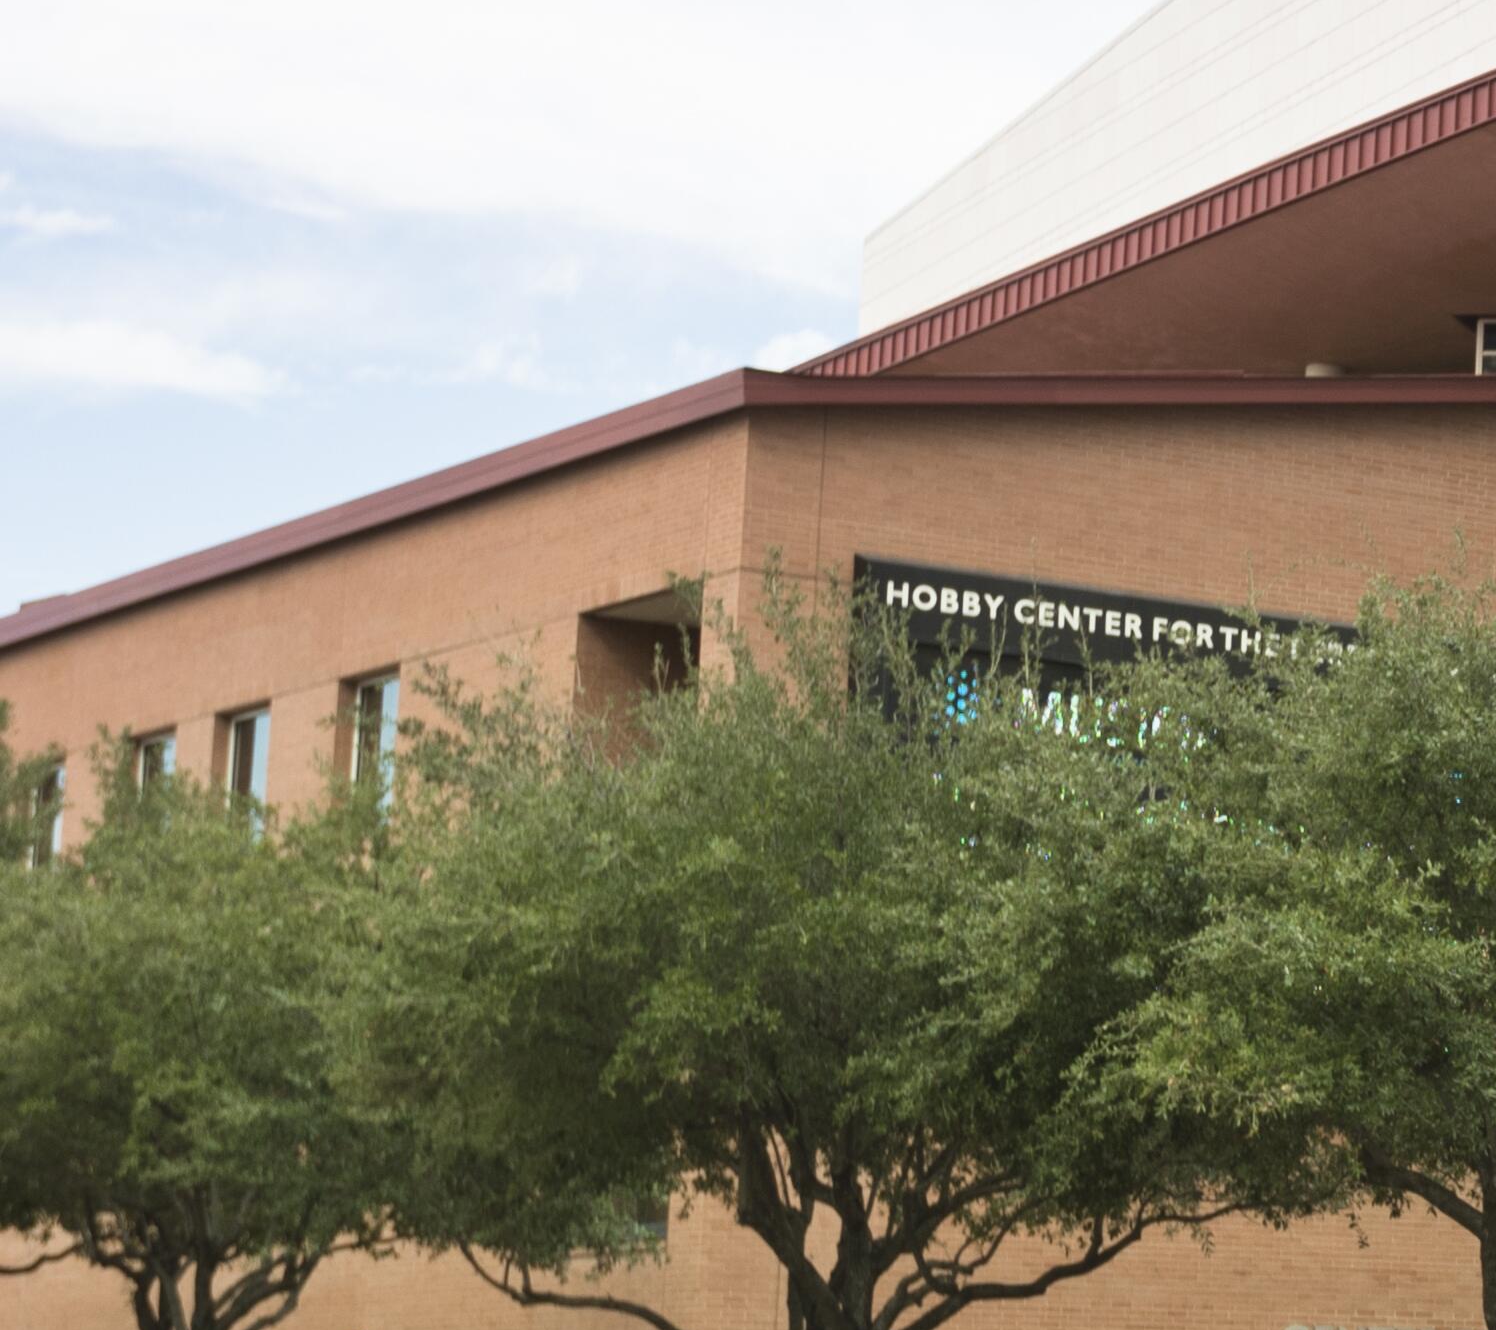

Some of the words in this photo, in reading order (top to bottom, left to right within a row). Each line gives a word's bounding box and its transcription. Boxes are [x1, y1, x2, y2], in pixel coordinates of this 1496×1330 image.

[886, 580, 1004, 620] HOBBY
[1014, 599, 1142, 640] CENTER
[1153, 616, 1214, 649] FOR
[1219, 626, 1280, 658] THE
